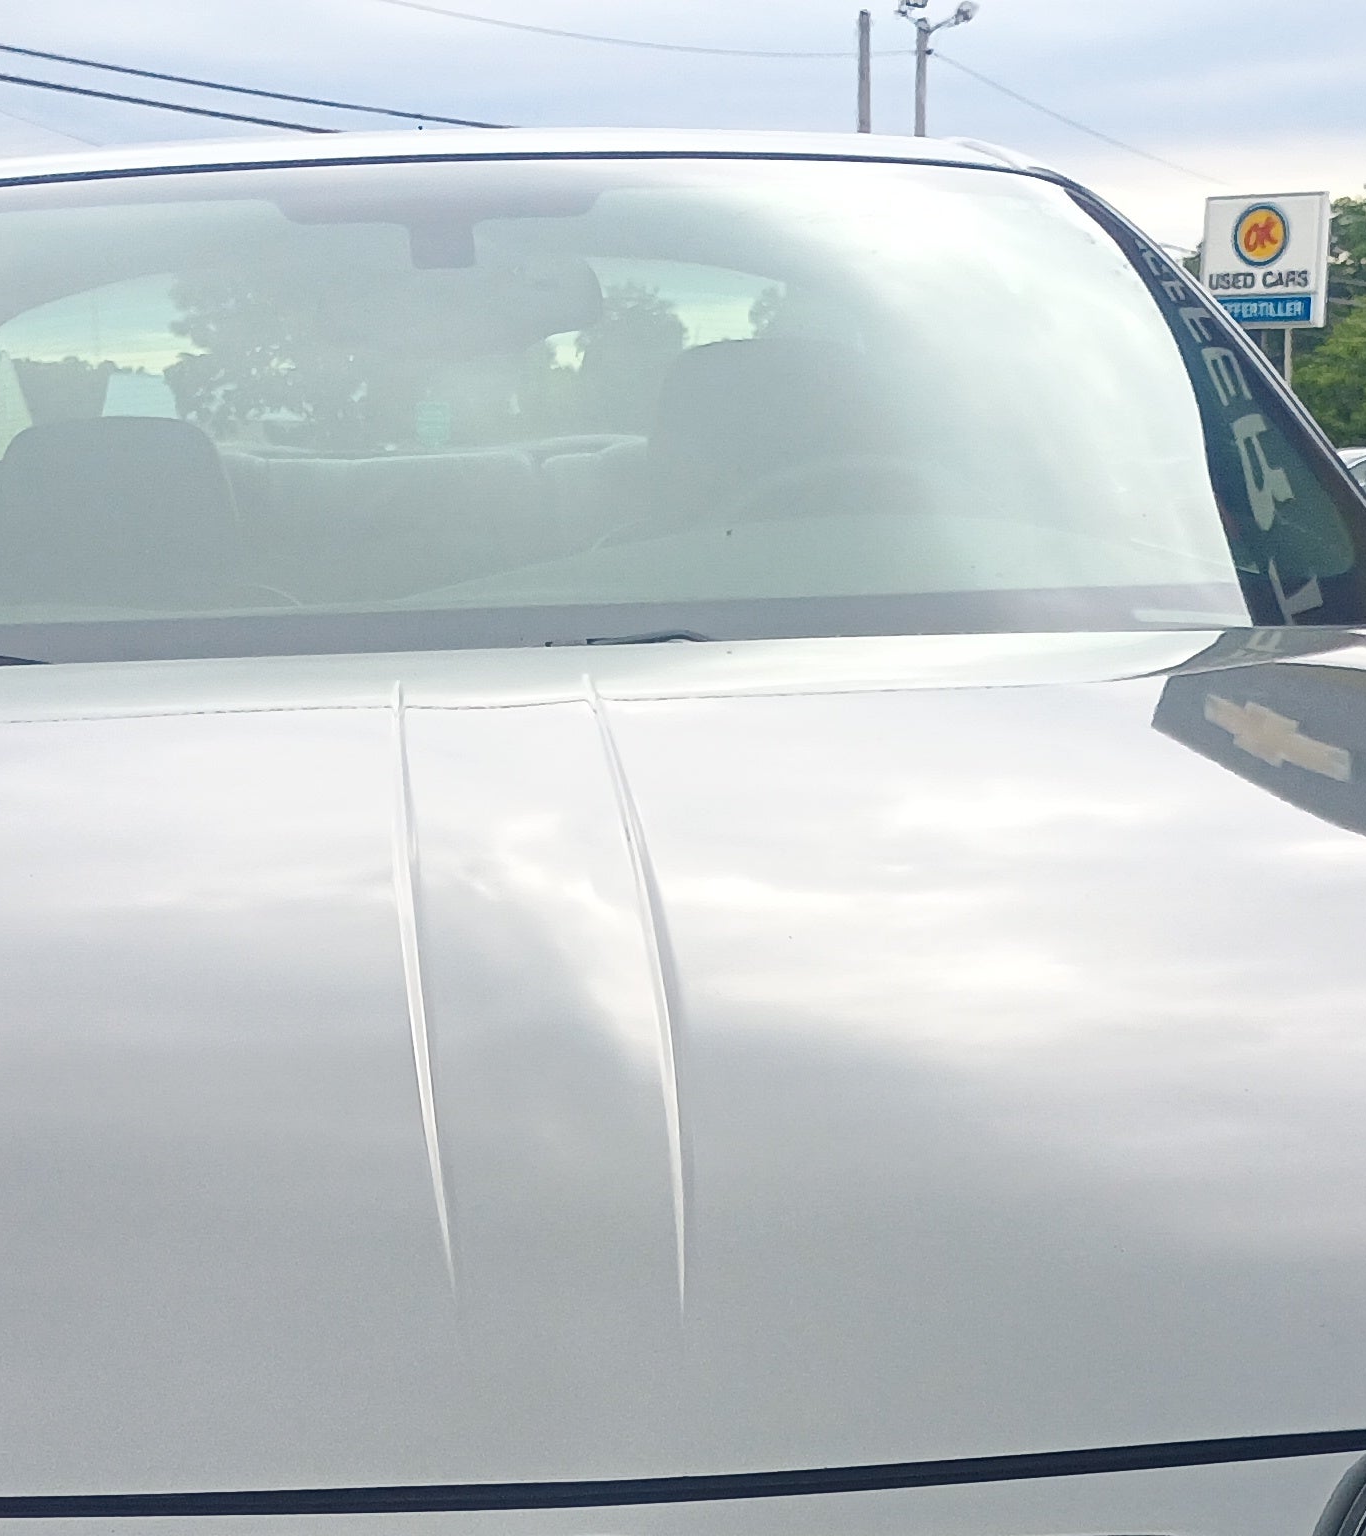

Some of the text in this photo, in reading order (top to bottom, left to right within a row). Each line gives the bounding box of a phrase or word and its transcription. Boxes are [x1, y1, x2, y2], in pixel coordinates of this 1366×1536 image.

[1243, 216, 1278, 252] OK
[1209, 270, 1308, 290] USED CARS
